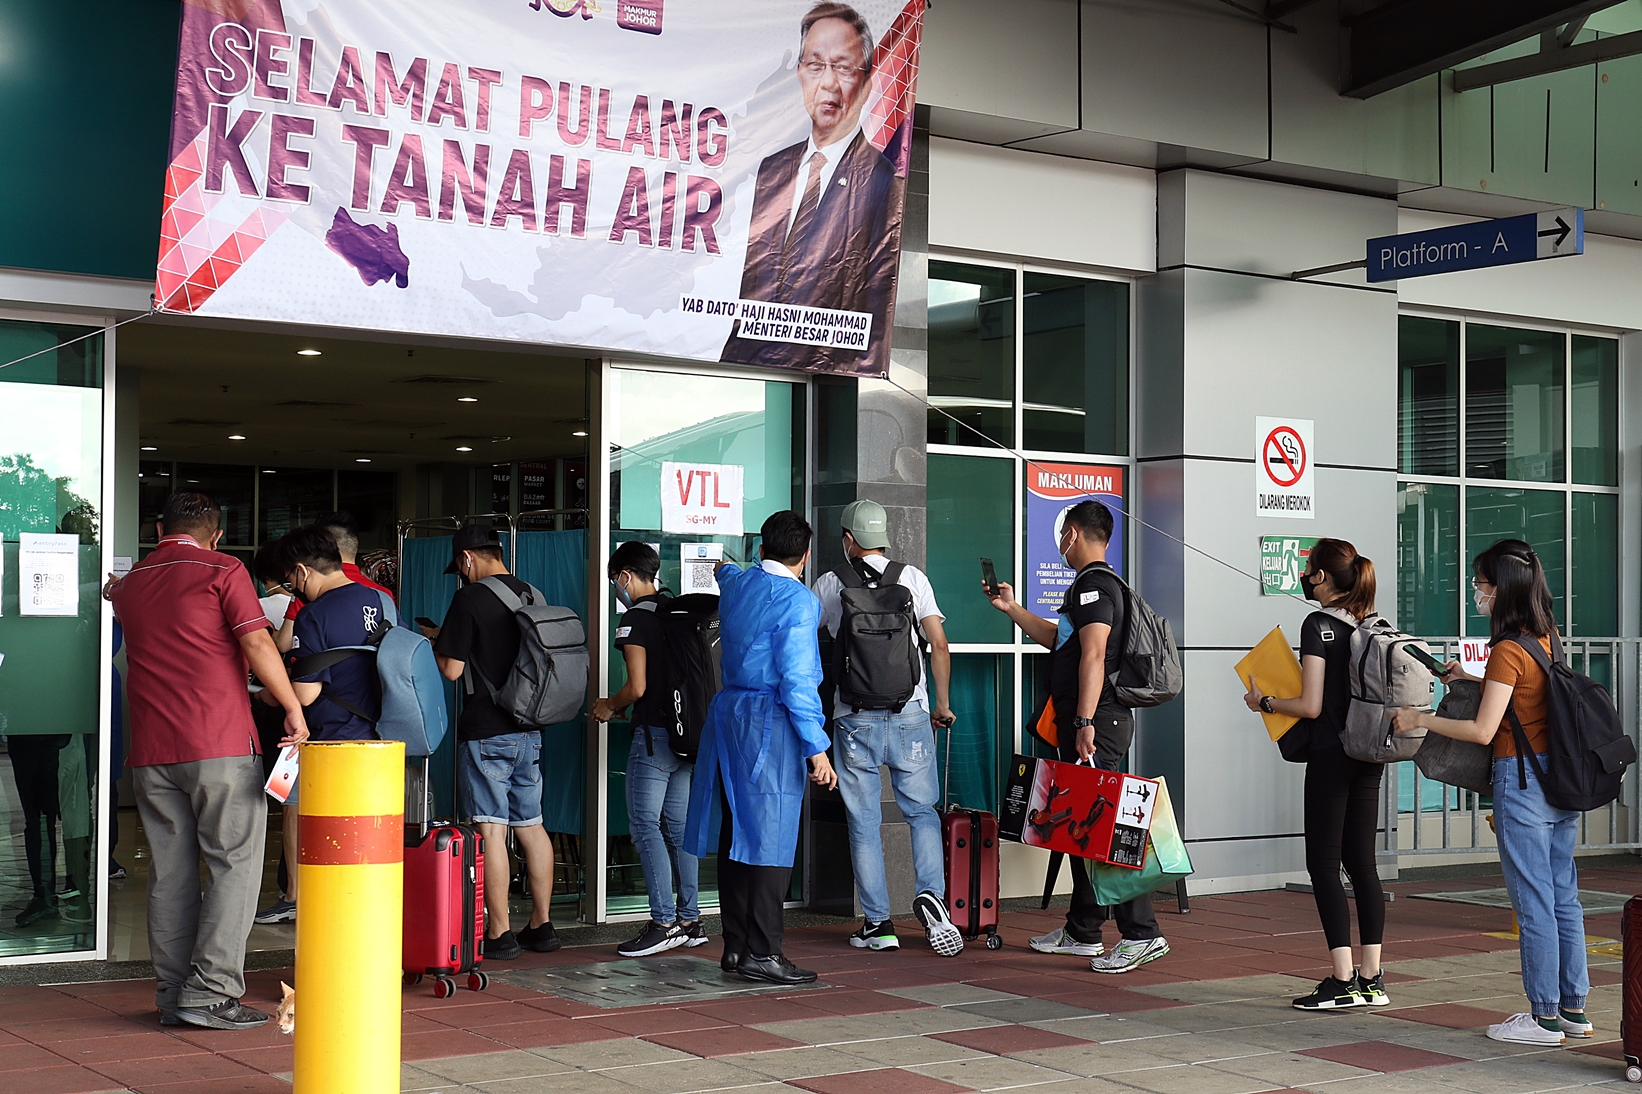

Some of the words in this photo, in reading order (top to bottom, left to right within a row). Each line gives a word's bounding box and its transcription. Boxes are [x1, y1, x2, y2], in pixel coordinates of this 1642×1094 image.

[623, 5, 657, 18] MAKMUR
[623, 13, 656, 27] JOHOR
[205, 22, 503, 134] SELAMAT
[518, 74, 729, 168] PULANG
[202, 102, 317, 206] KE
[340, 123, 591, 240] TANAH
[607, 166, 724, 256] AIR
[1381, 240, 1467, 270] Platform
[1491, 231, 1509, 254] A
[682, 297, 704, 313] YAB
[706, 300, 739, 317] DATO'
[741, 304, 765, 322] HAJI
[767, 306, 801, 324] HASNI
[803, 310, 867, 331] MOHAMMAD
[742, 321, 793, 339] MENTERI
[794, 325, 829, 343] BESAR
[830, 330, 865, 347] JOHOR
[524, 475, 545, 483] PASAR
[1038, 472, 1112, 491] MAKLUMAN
[676, 469, 730, 508] VTL
[1260, 494, 1285, 510] DILARANG
[1286, 495, 1311, 511] MEROKOK
[685, 514, 717, 525] SG-MY
[1263, 541, 1281, 553] EXIT
[1263, 556, 1283, 571] KELUAR
[1263, 572, 1280, 586] 出口
